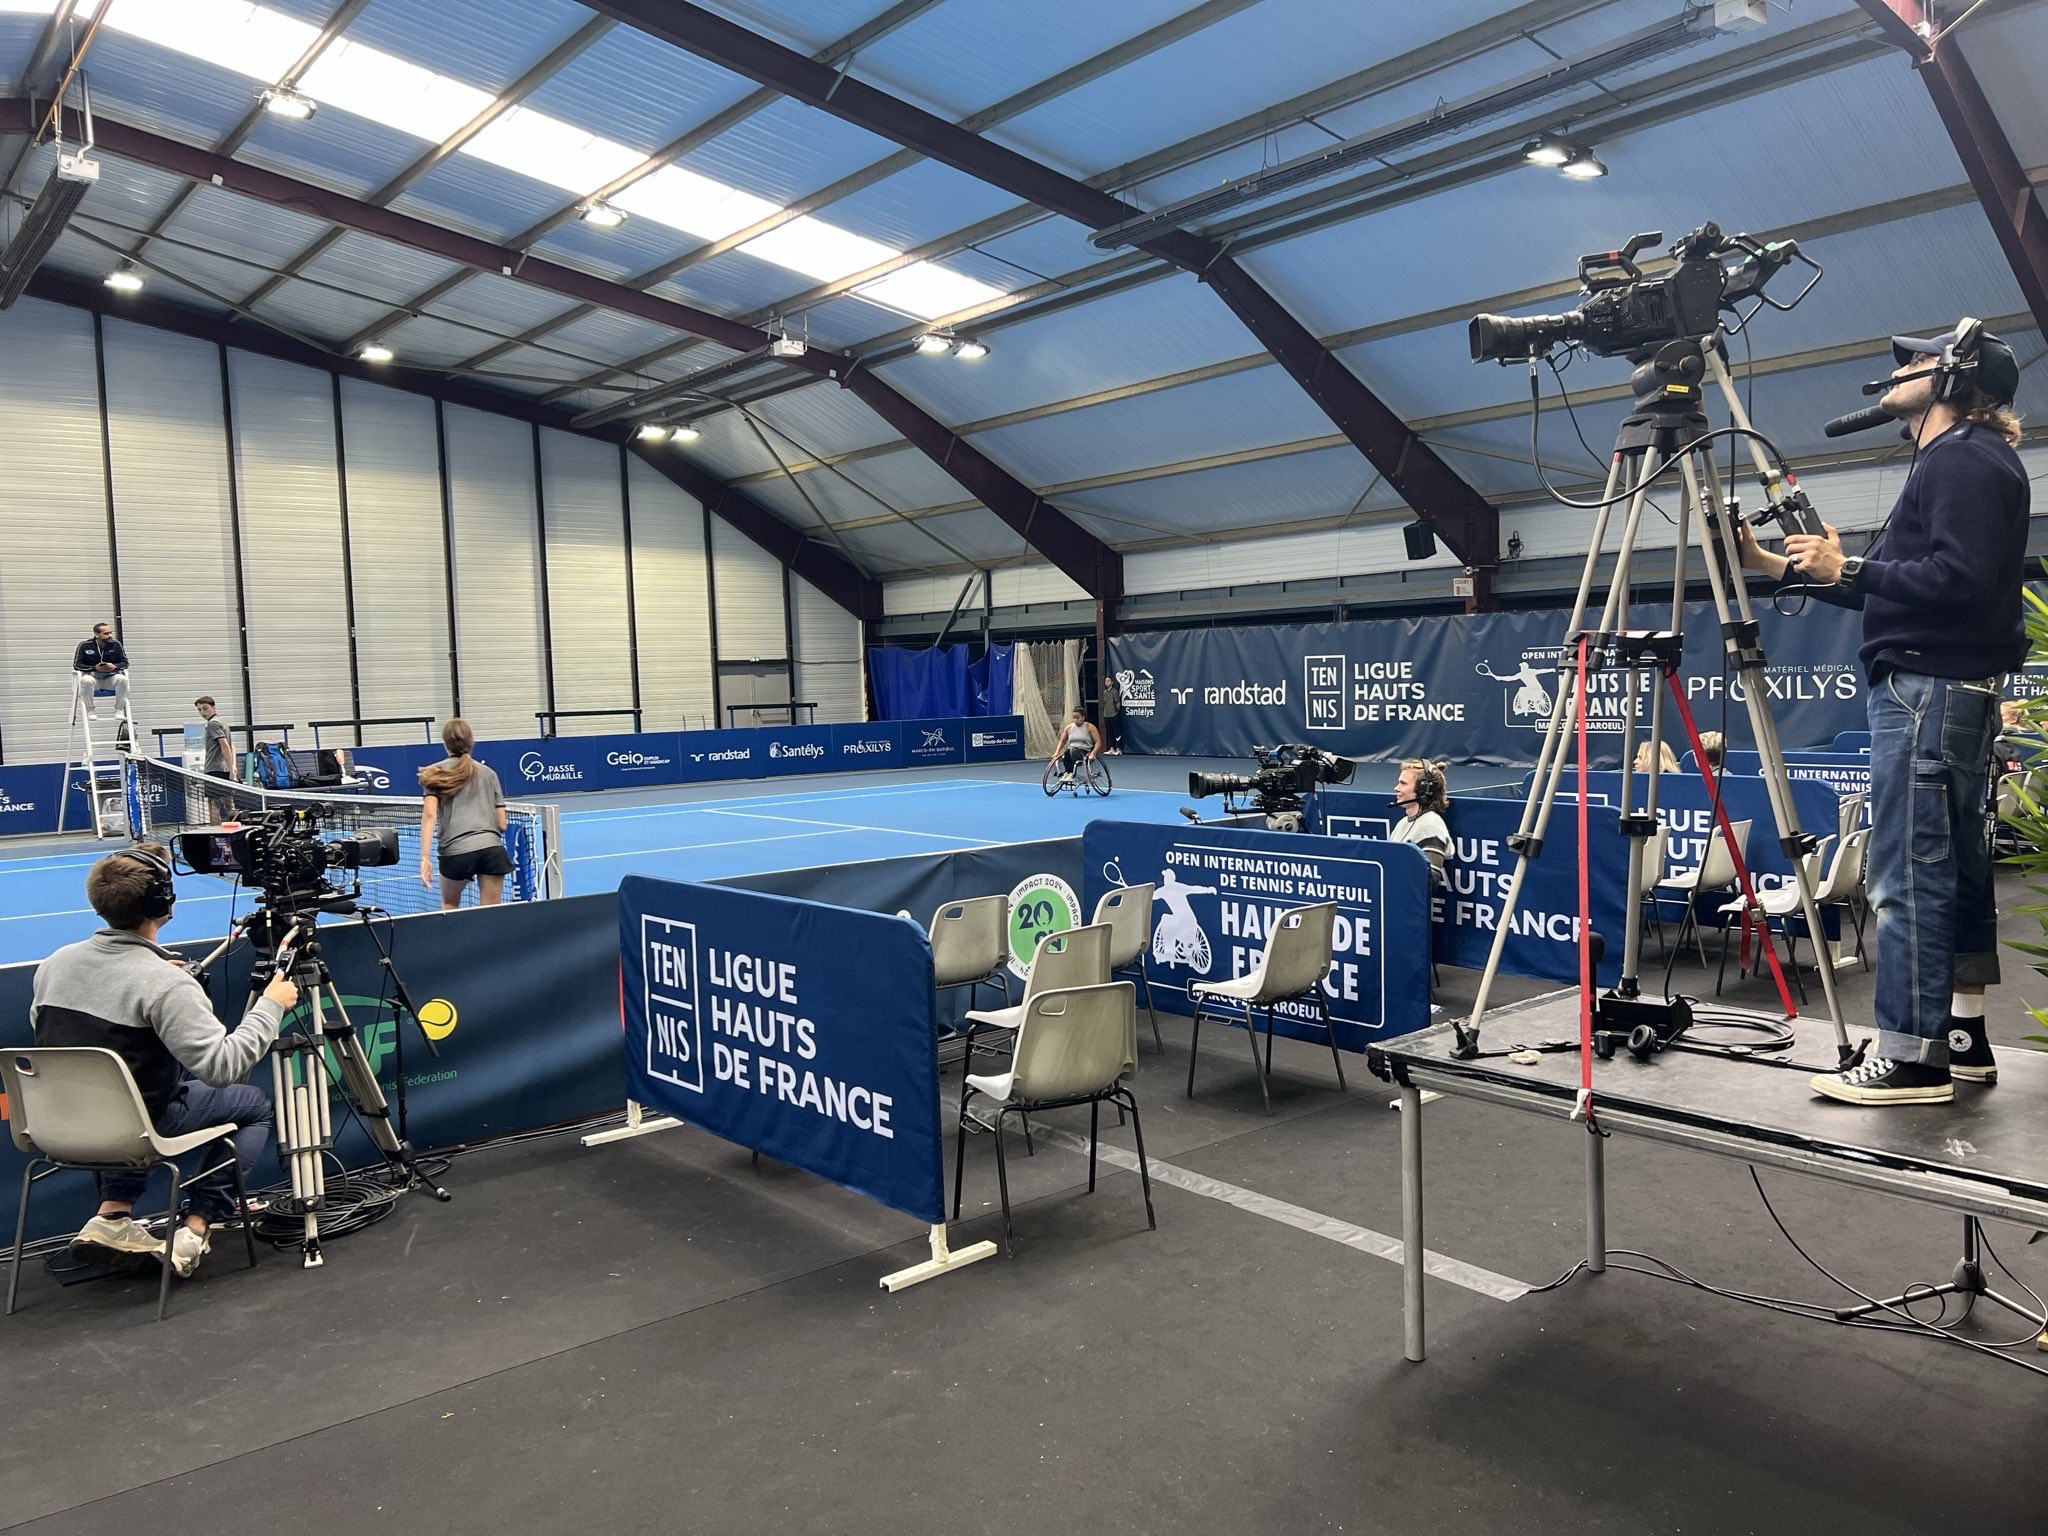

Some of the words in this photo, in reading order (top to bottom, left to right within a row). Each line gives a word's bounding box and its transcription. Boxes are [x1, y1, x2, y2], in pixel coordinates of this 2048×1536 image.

[1521, 651, 1545, 660] OPEN
[1311, 667, 1337, 687] TEN
[1354, 661, 1413, 680] LIGUE
[1764, 666, 1809, 674] MATÉRIEL
[1814, 664, 1856, 672] MÉDICAL
[1134, 689, 1156, 699] SANTÉ
[1204, 680, 1286, 706] randstad
[1354, 682, 1426, 701] HAUTS
[2013, 686, 2028, 696] ET
[1125, 707, 1154, 718] Santélys
[1312, 699, 1337, 719] NIS
[1354, 705, 1380, 721] DE
[1385, 704, 1465, 723] FRANCE
[708, 748, 750, 762] randstad
[782, 744, 824, 760] Santélys
[541, 771, 583, 782] MURAILLE
[548, 764, 576, 773] PASSE
[0, 802, 34, 812] RANCE
[1165, 850, 1200, 867] OPEN
[1203, 854, 1322, 880] INTERNATIONAL
[1016, 878, 1043, 898] IMPACT
[1045, 879, 1064, 891] 2024
[1219, 873, 1237, 888] DE
[1240, 875, 1294, 894] TENNIS
[1298, 881, 1372, 904] FAUTEUIL
[650, 940, 687, 990] TEN
[709, 947, 798, 1005] LIGUE
[710, 994, 817, 1060] HAUTS
[655, 1012, 690, 1063] NIS
[712, 1041, 751, 1090] DE
[758, 1055, 894, 1140] FRANCE
